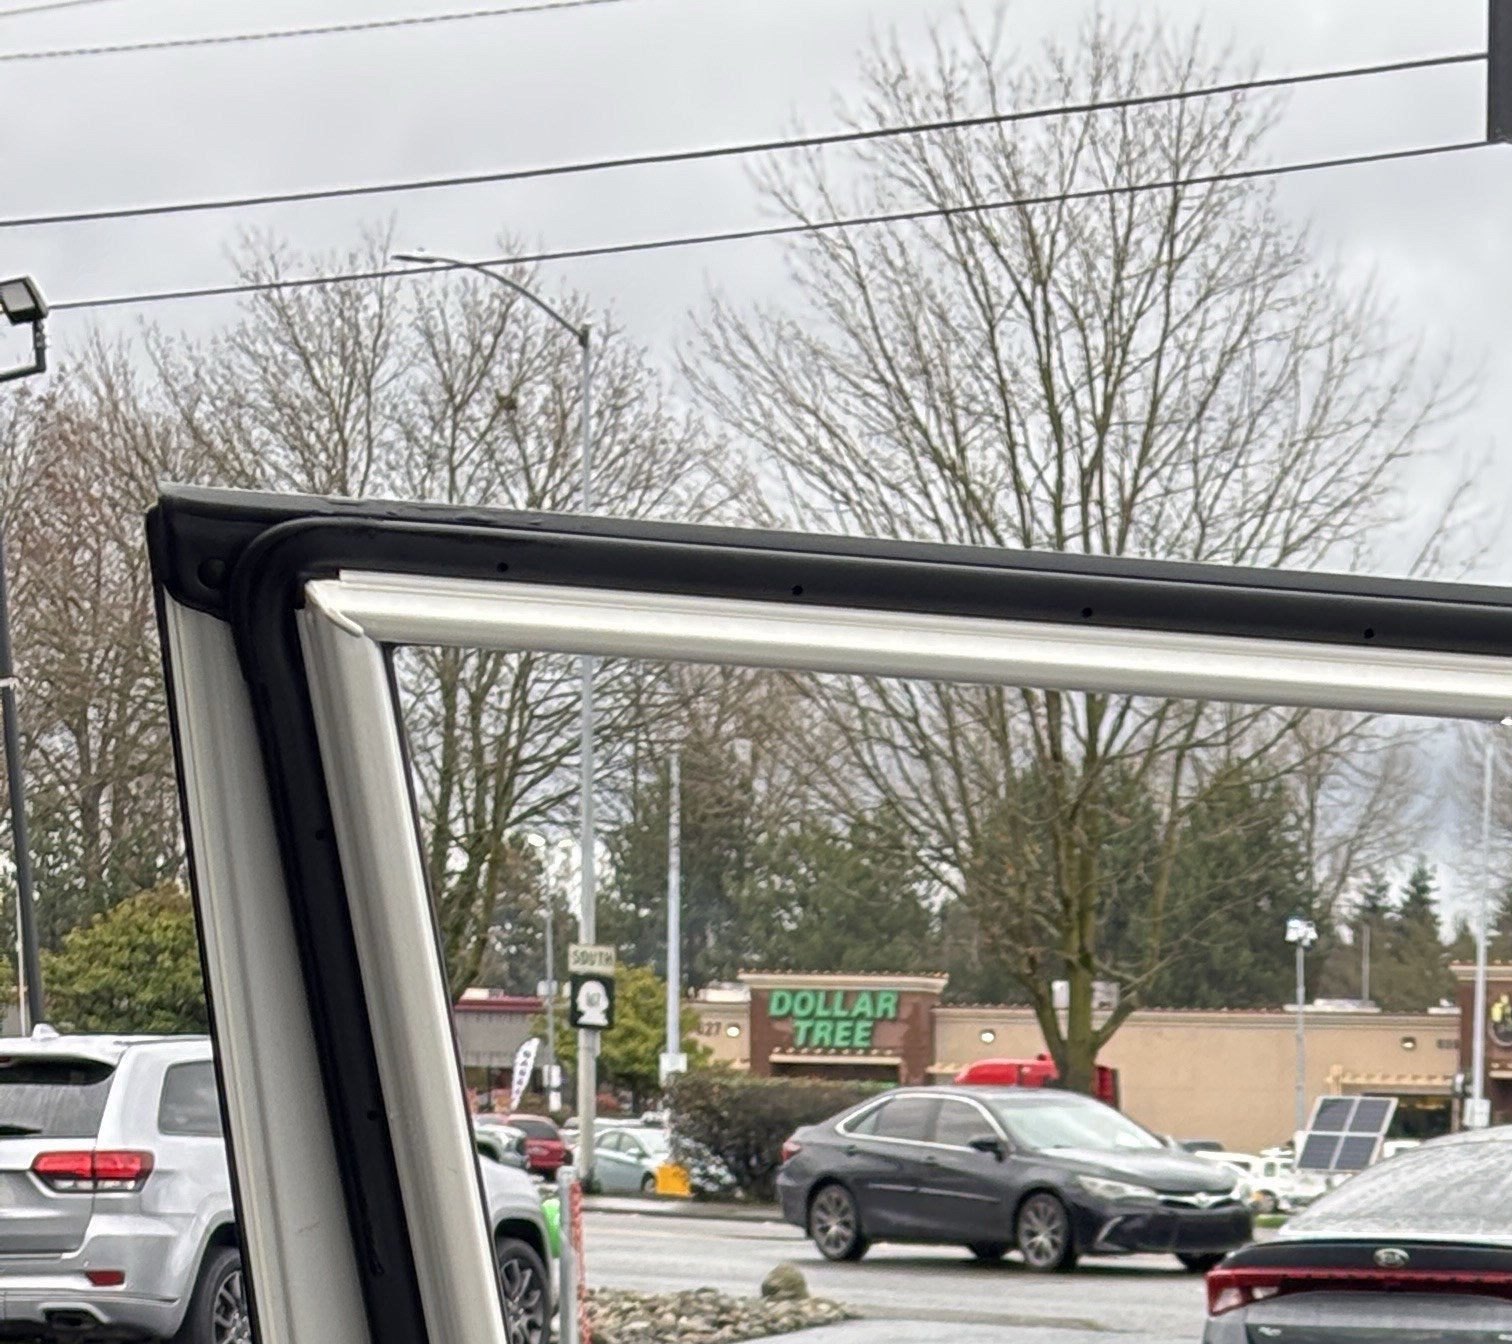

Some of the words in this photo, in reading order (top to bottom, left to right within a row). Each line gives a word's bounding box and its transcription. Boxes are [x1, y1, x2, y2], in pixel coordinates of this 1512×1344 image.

[573, 949, 612, 966] SOUTH
[768, 988, 899, 1018] DOLLAR
[792, 1019, 875, 1048] TREE
